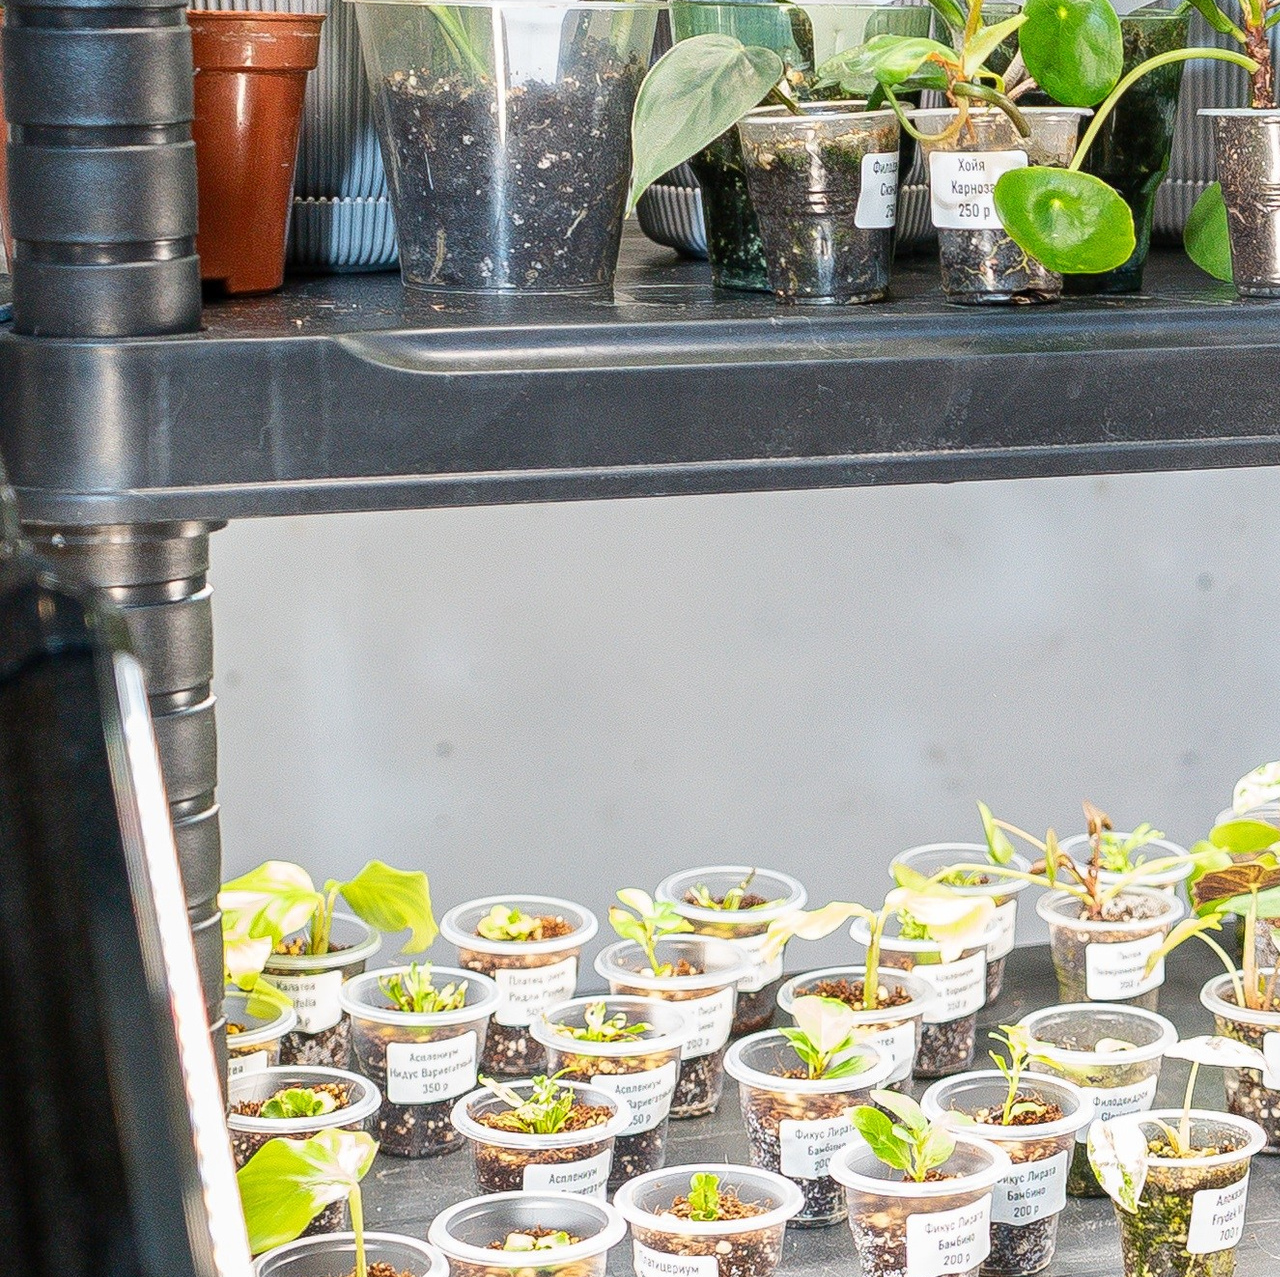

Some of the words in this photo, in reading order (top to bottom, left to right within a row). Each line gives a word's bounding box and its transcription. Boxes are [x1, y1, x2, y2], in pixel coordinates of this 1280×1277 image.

[958, 158, 986, 172] Хойя
[959, 203, 979, 218] 250
[795, 1129, 826, 1142] Фикус
[549, 1167, 598, 1184] Асплениум
[996, 1175, 1025, 1186] икус
[1027, 1166, 1057, 1183] Лирата
[1007, 1187, 1046, 1202] Бамбино
[1013, 1205, 1032, 1218] 200
[924, 1221, 956, 1234] Фикус
[938, 1232, 976, 1251] Бамбино
[943, 1253, 964, 1266] 200
